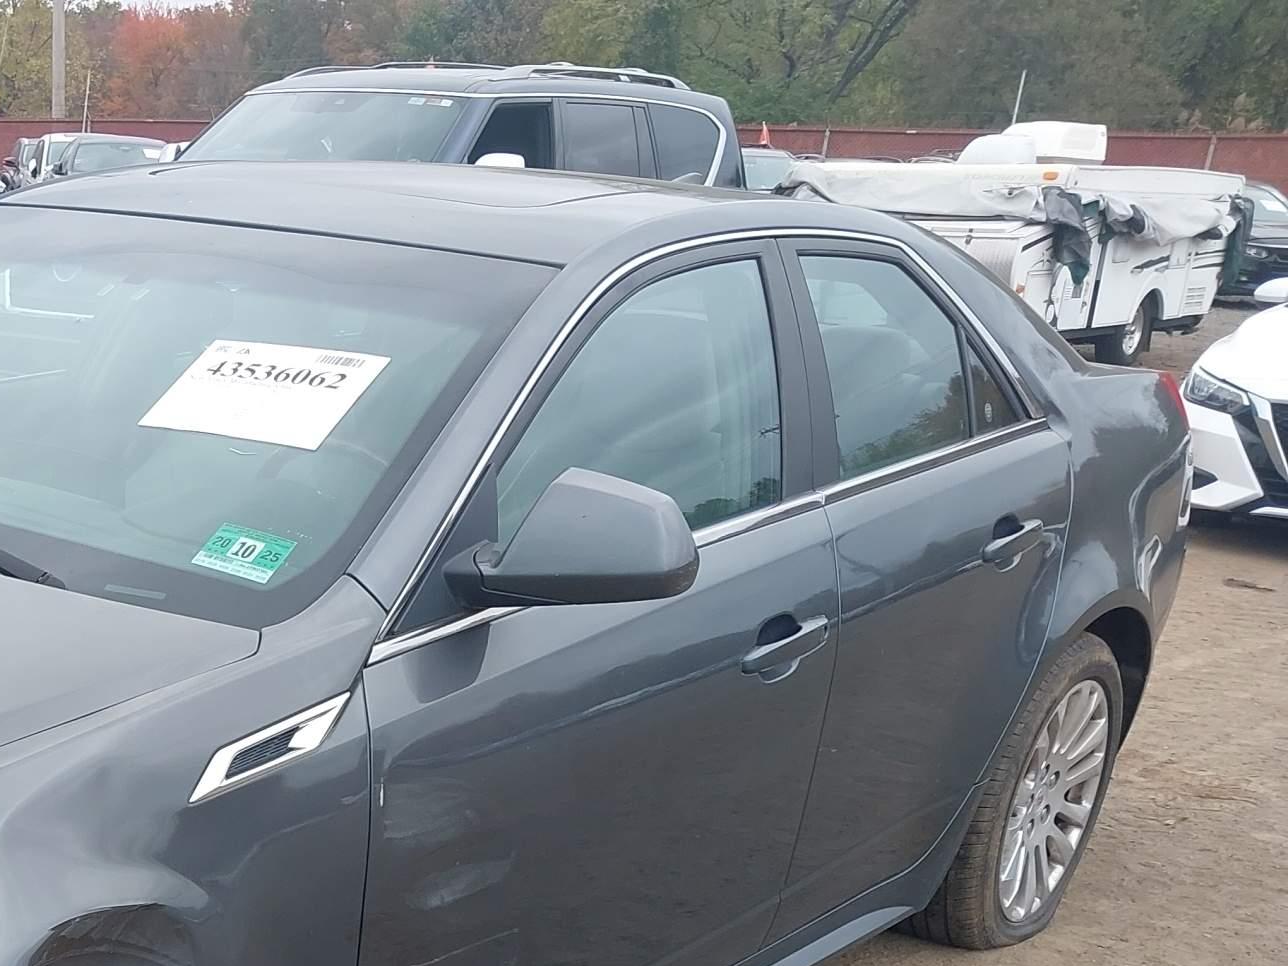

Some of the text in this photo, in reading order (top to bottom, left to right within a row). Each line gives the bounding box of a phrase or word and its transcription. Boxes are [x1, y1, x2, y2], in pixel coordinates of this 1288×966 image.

[206, 360, 348, 390] 43536062
[212, 536, 232, 549] 20
[231, 541, 257, 560] 10
[259, 549, 283, 563] 25
